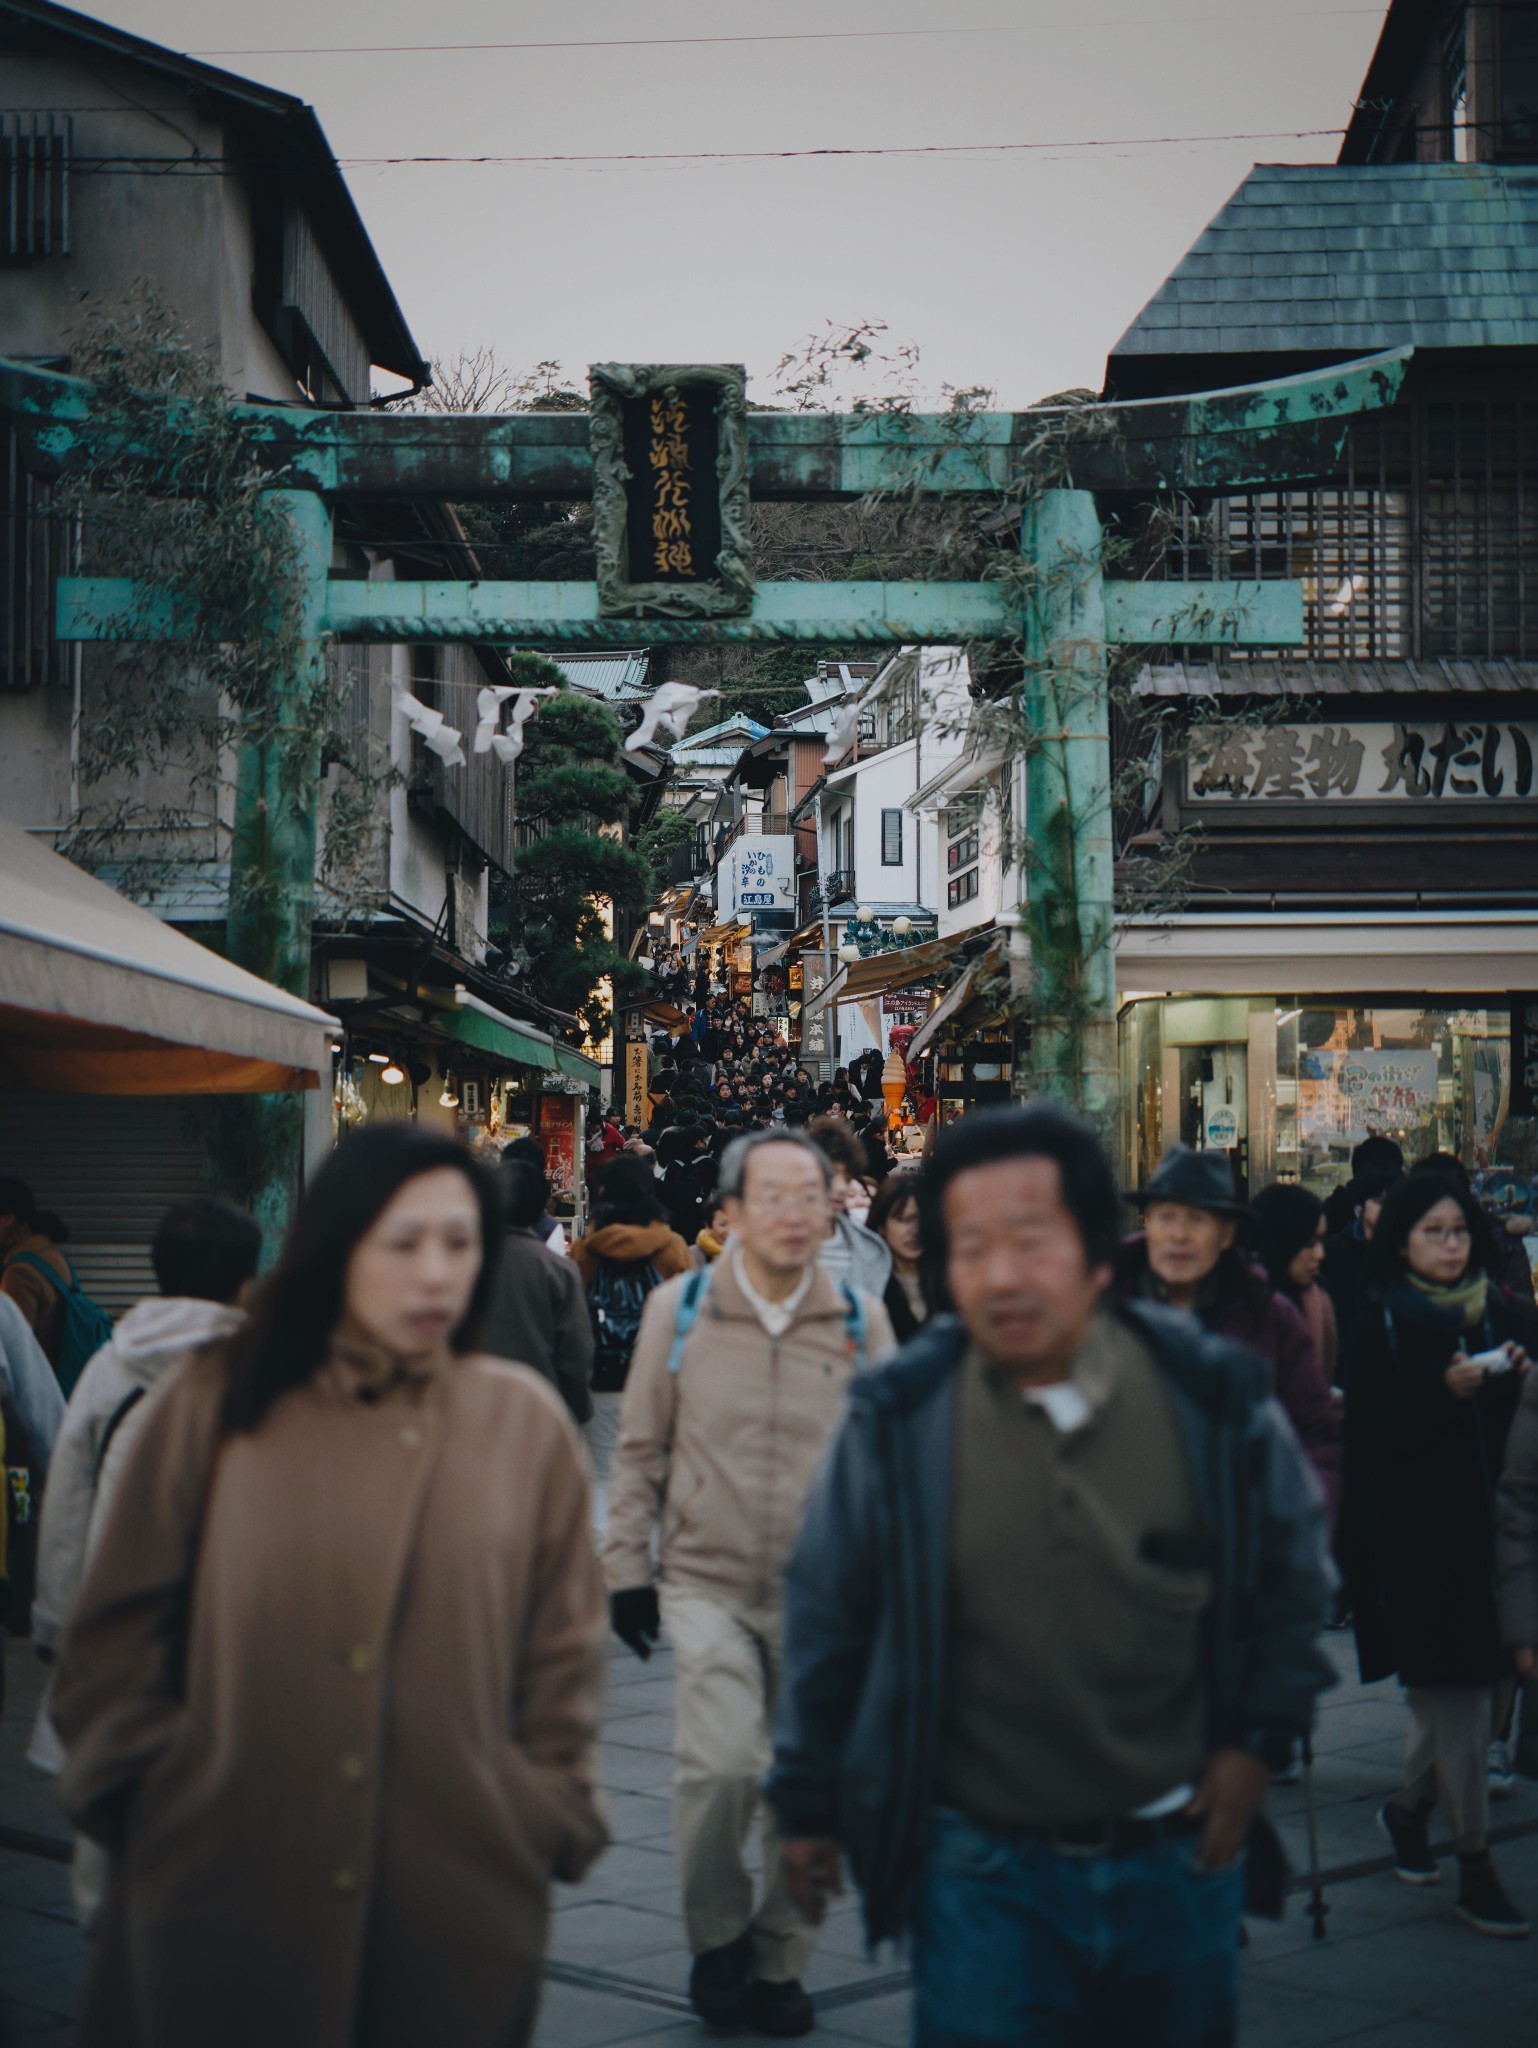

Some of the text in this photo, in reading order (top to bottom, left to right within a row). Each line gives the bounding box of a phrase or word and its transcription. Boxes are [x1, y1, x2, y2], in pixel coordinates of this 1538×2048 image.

[1194, 721, 1534, 799] 海産物 丸だい
[757, 852, 766, 887] ひもの
[743, 894, 772, 905] 江島屋
